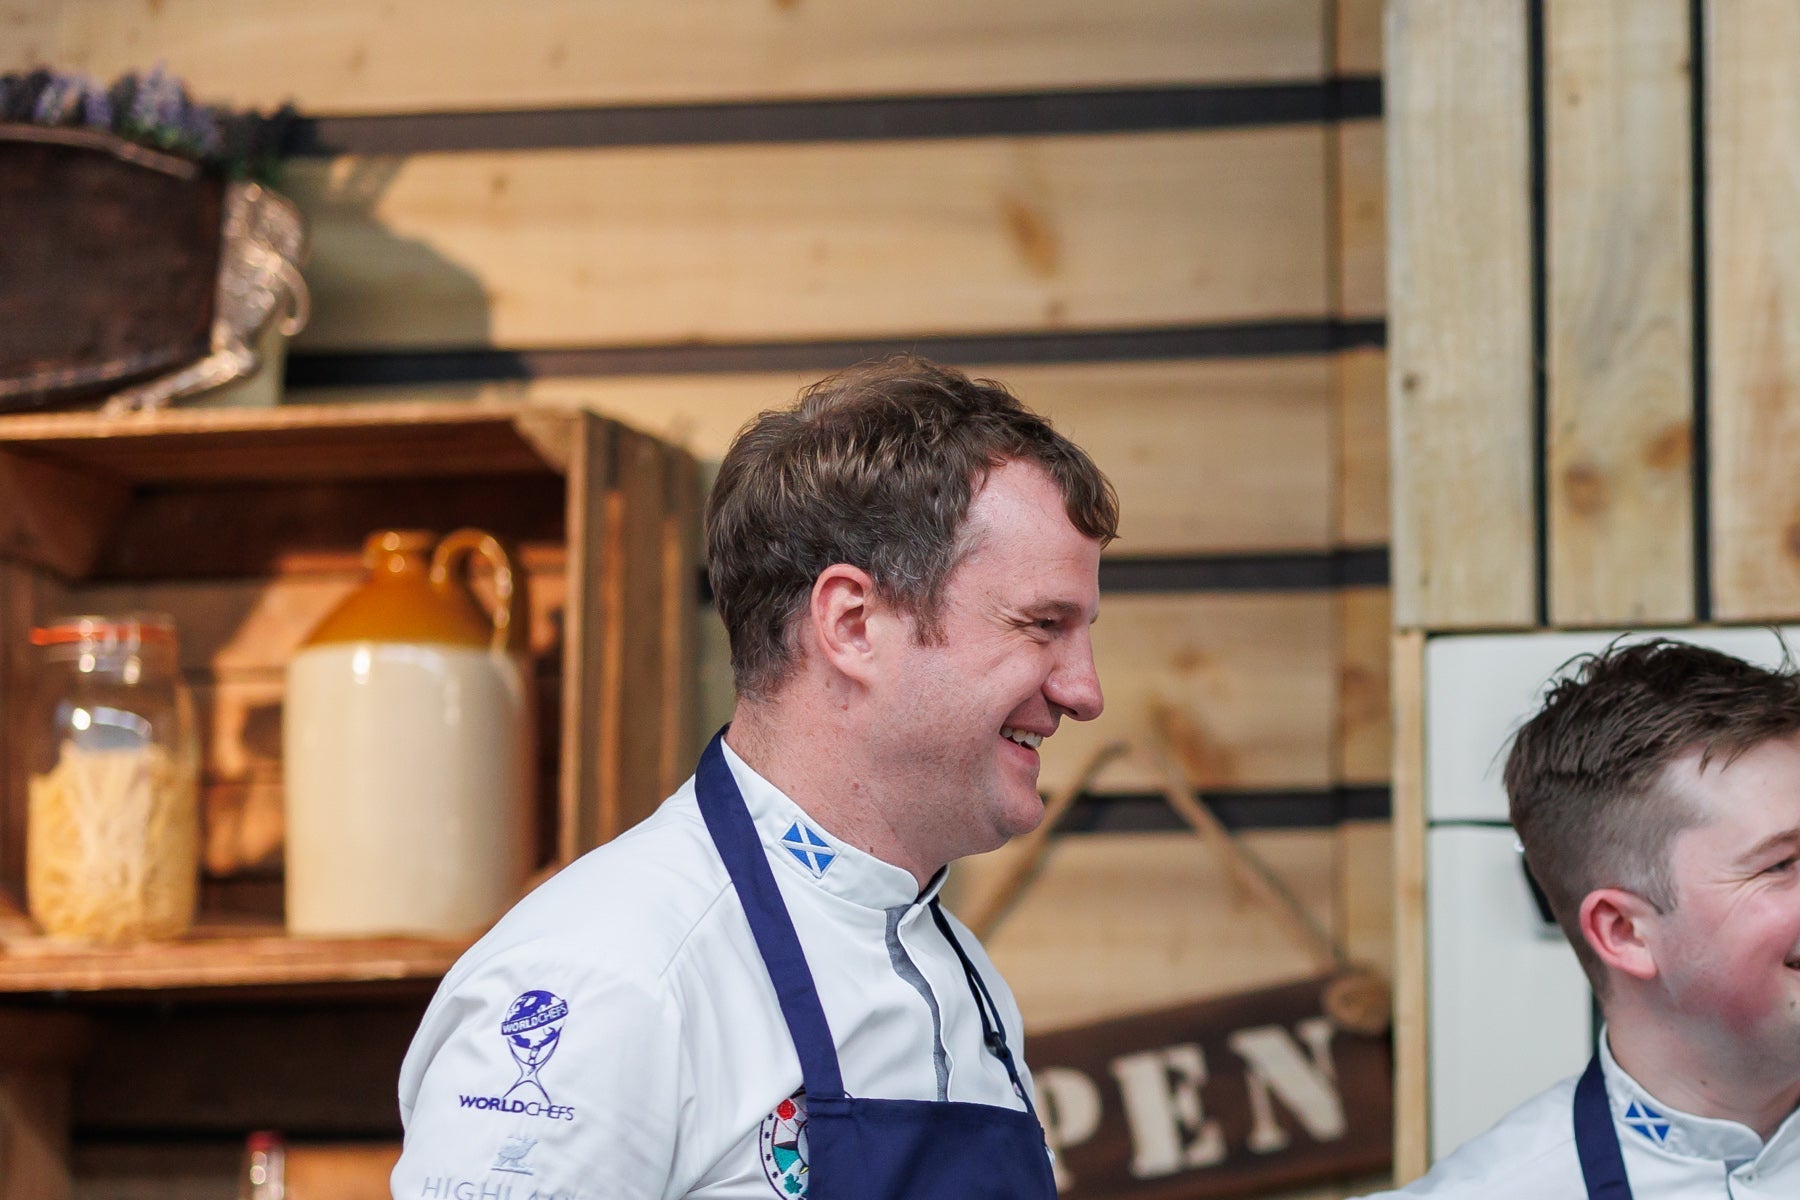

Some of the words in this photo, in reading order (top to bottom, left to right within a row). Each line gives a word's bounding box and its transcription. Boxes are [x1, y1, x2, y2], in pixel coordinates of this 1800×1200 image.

[502, 1003, 568, 1034] WORLDCHEFS
[459, 1094, 576, 1121] WORLDCHEFS
[1033, 1017, 1348, 1193] PEN
